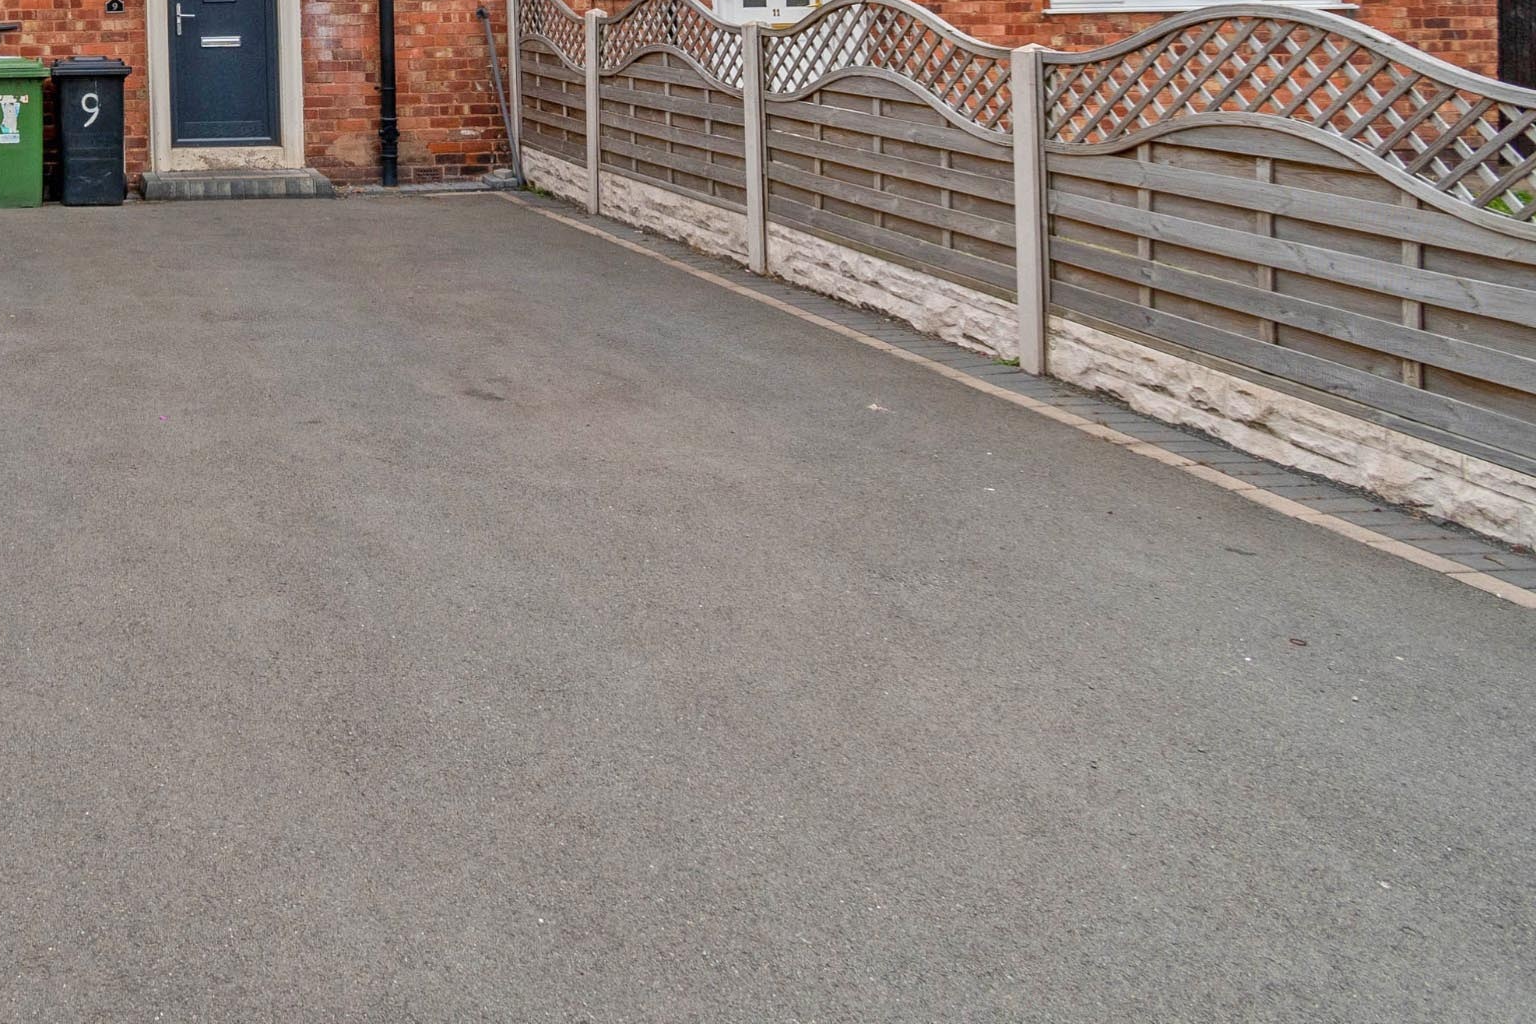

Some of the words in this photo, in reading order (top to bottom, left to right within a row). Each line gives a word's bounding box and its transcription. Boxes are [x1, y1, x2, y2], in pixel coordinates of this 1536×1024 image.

[112, 2, 118, 11] 9
[772, 8, 780, 17] 11
[81, 92, 99, 127] 9
